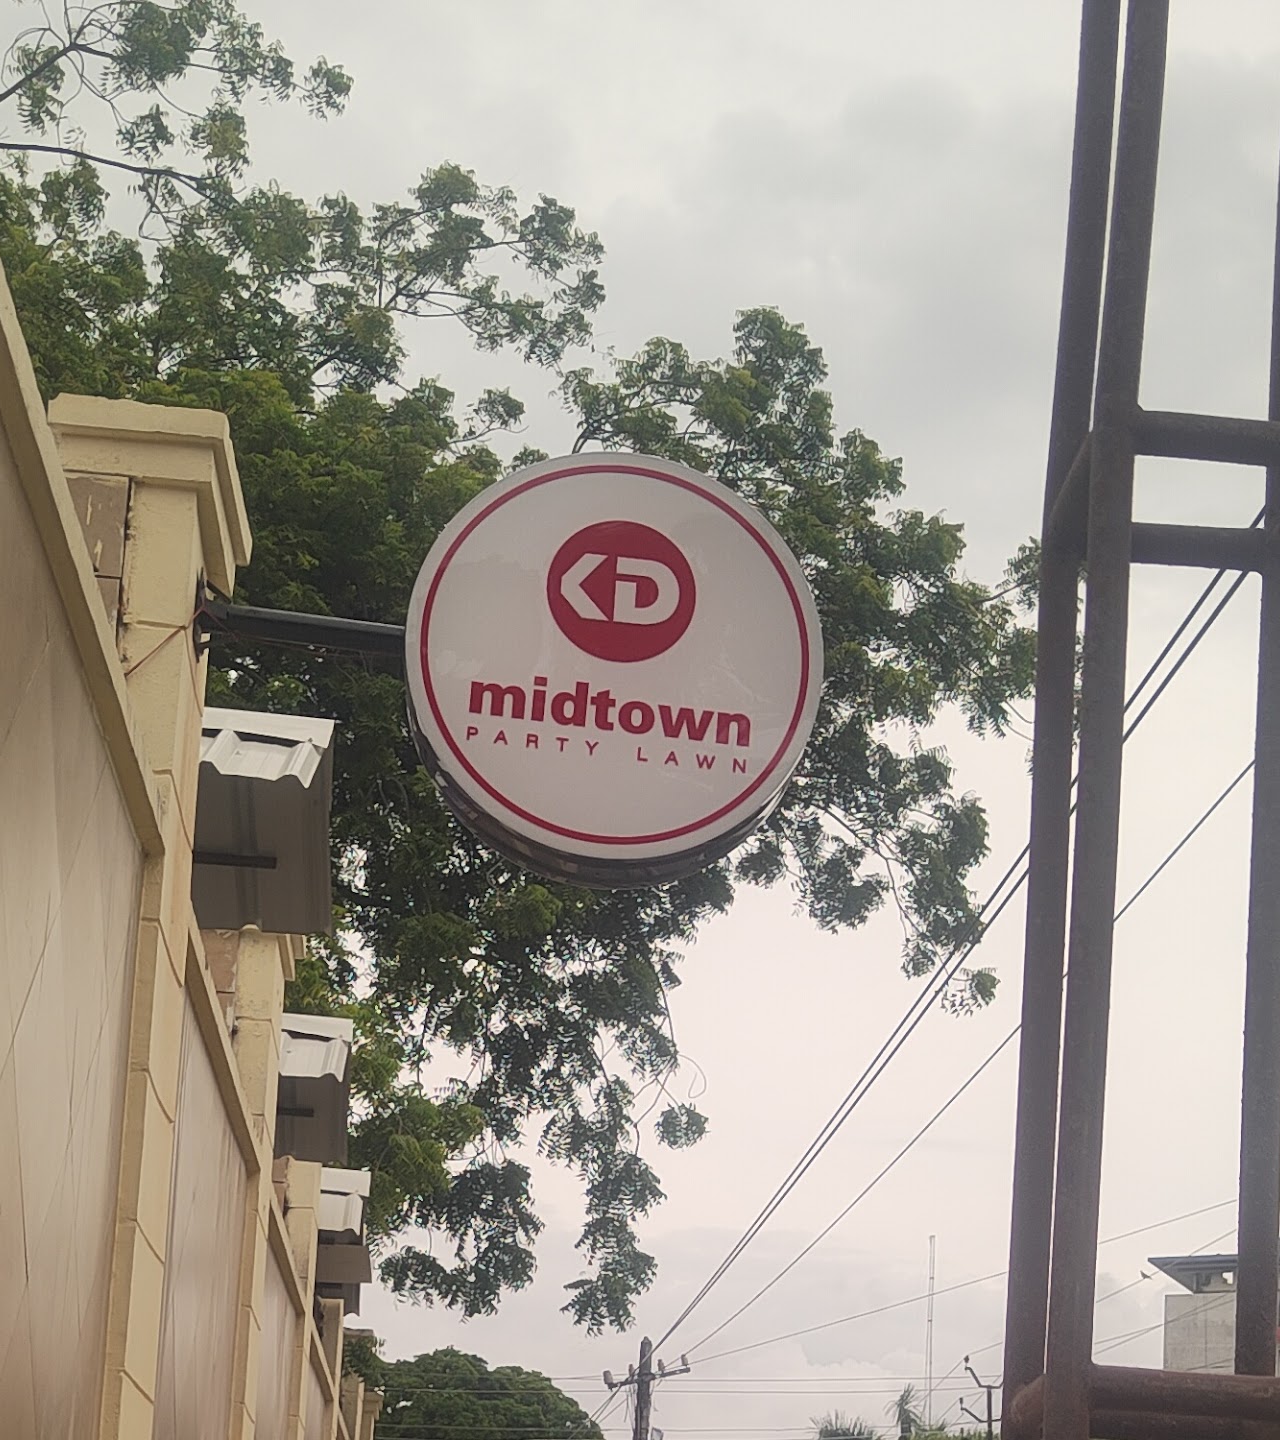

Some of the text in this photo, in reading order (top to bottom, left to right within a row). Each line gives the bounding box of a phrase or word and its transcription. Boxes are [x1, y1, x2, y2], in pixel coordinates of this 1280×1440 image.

[467, 675, 752, 748] midtown
[464, 724, 749, 775] PARTY LAWN
